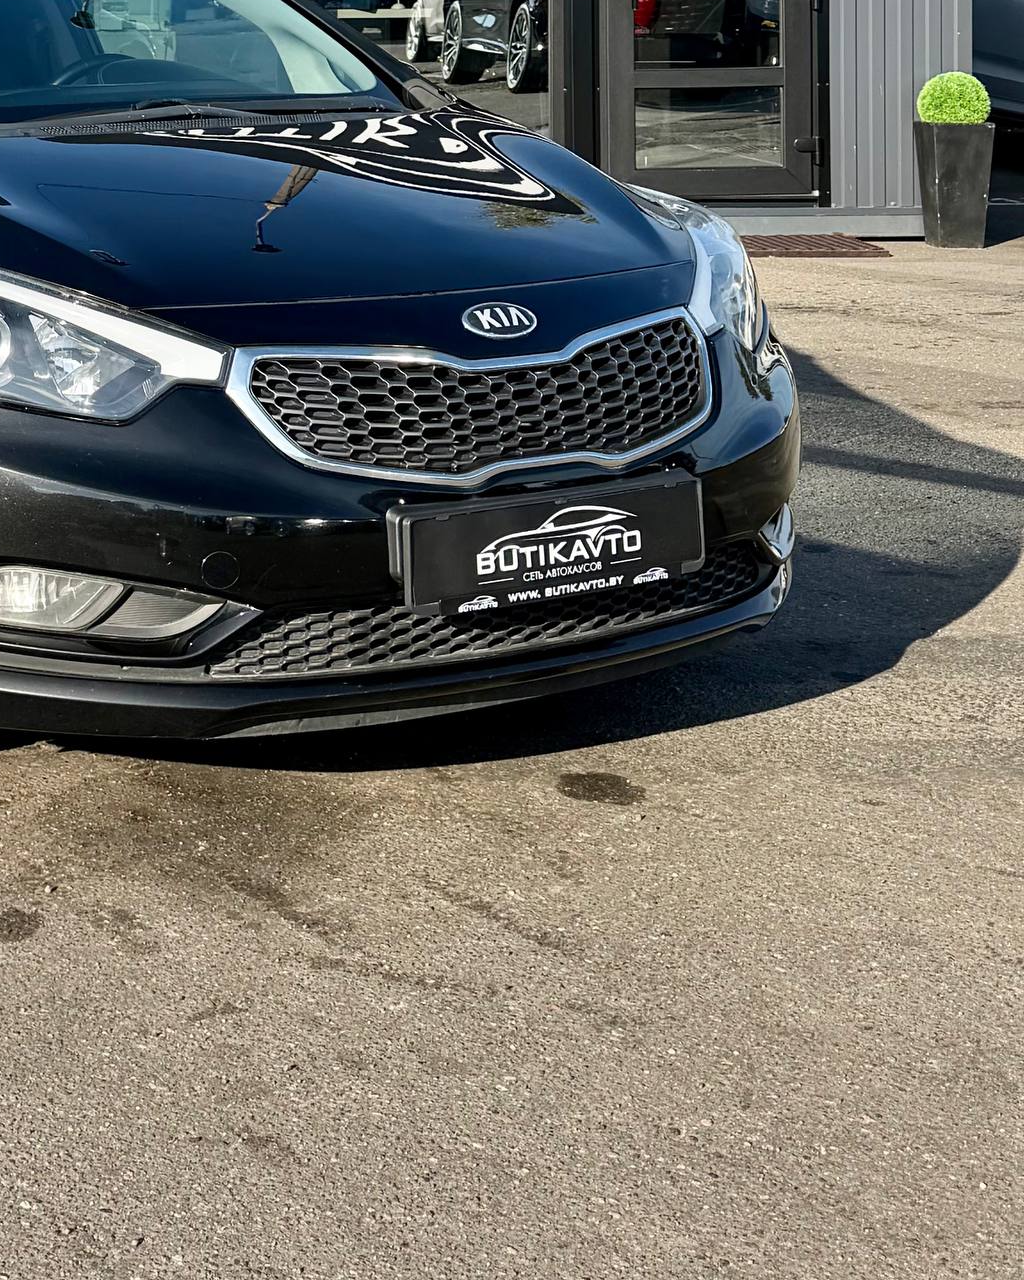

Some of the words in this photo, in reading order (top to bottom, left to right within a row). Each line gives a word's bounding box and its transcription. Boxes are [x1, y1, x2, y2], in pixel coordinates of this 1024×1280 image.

[473, 307, 530, 330] KIA
[476, 530, 642, 576] BUTIKAVTO
[523, 571, 544, 582] СЕТЬ
[545, 561, 603, 579] АВТОХАУСОВ
[508, 589, 541, 602] WWW.
[545, 575, 624, 597] BUTIKAVTO.BY
